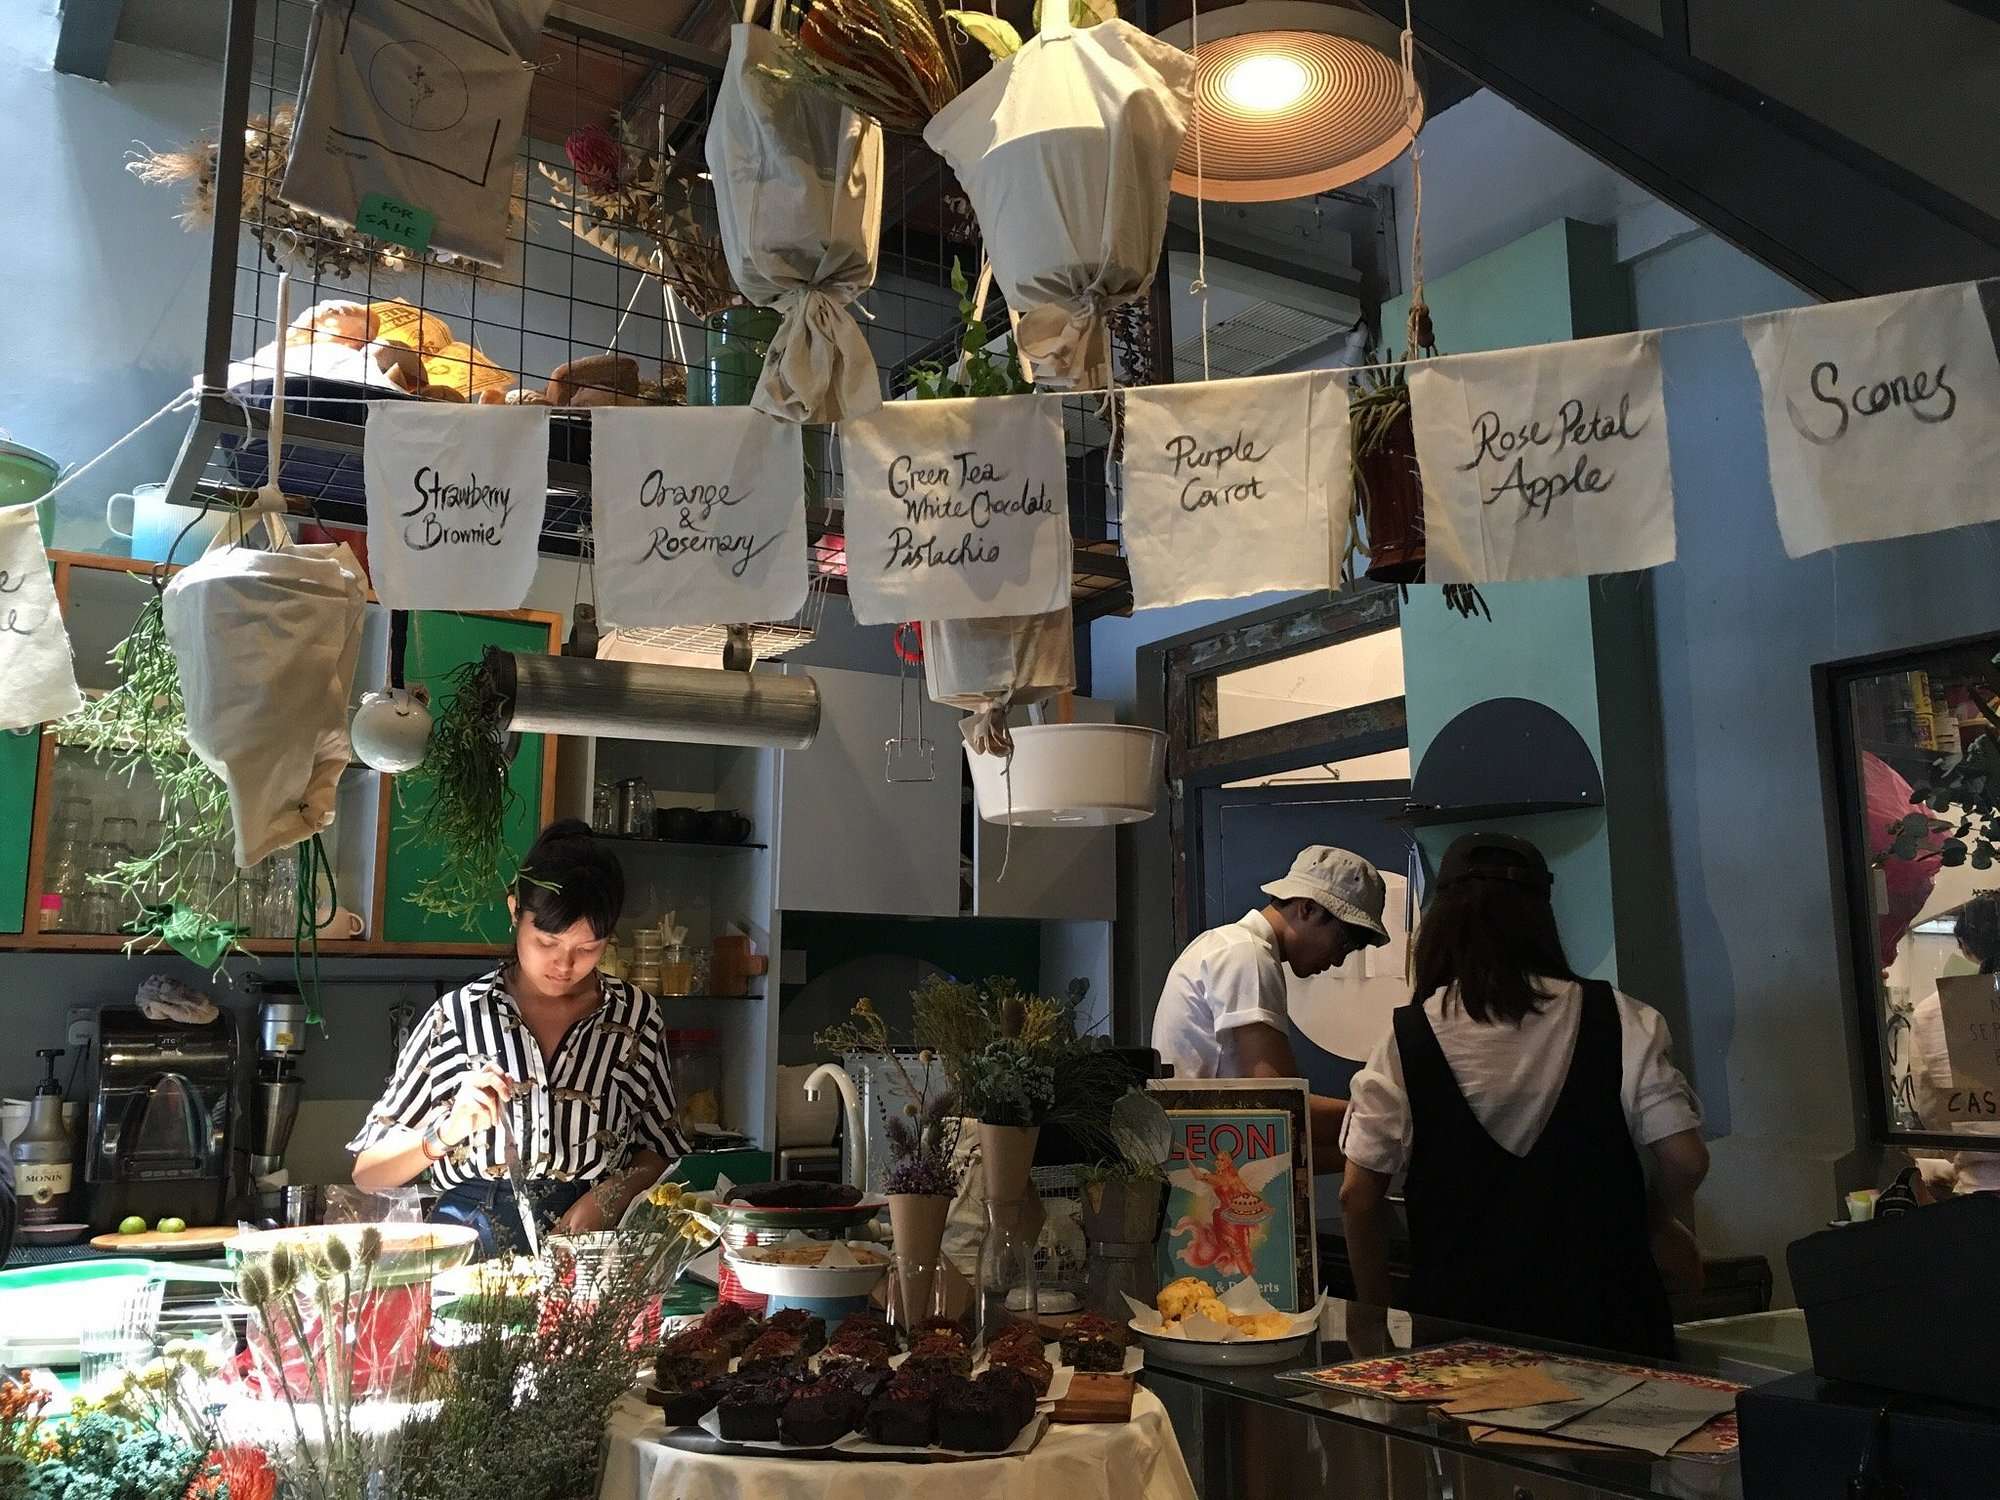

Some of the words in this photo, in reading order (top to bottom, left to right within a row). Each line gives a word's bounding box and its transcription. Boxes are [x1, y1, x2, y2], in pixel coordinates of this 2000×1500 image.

[365, 214, 417, 238] SALE
[381, 201, 413, 219] FOR
[1786, 361, 1957, 445] Scones
[1457, 410, 1551, 471] Rose
[1554, 392, 1649, 456] Petal
[888, 455, 950, 498] Green
[953, 452, 1004, 489] Tea
[1165, 430, 1272, 478] Purple
[401, 466, 518, 528] Strawberry
[640, 469, 752, 520] Orange
[904, 492, 968, 524] White
[1181, 476, 1266, 512] Carrot
[1483, 454, 1615, 524] Apple
[404, 512, 502, 550] Brownie
[679, 507, 706, 532] &
[632, 527, 787, 577] Rosemary
[884, 526, 1000, 570] Pistachio
[25, 1174, 63, 1183] MONIN
[1215, 1281, 1225, 1293] &
